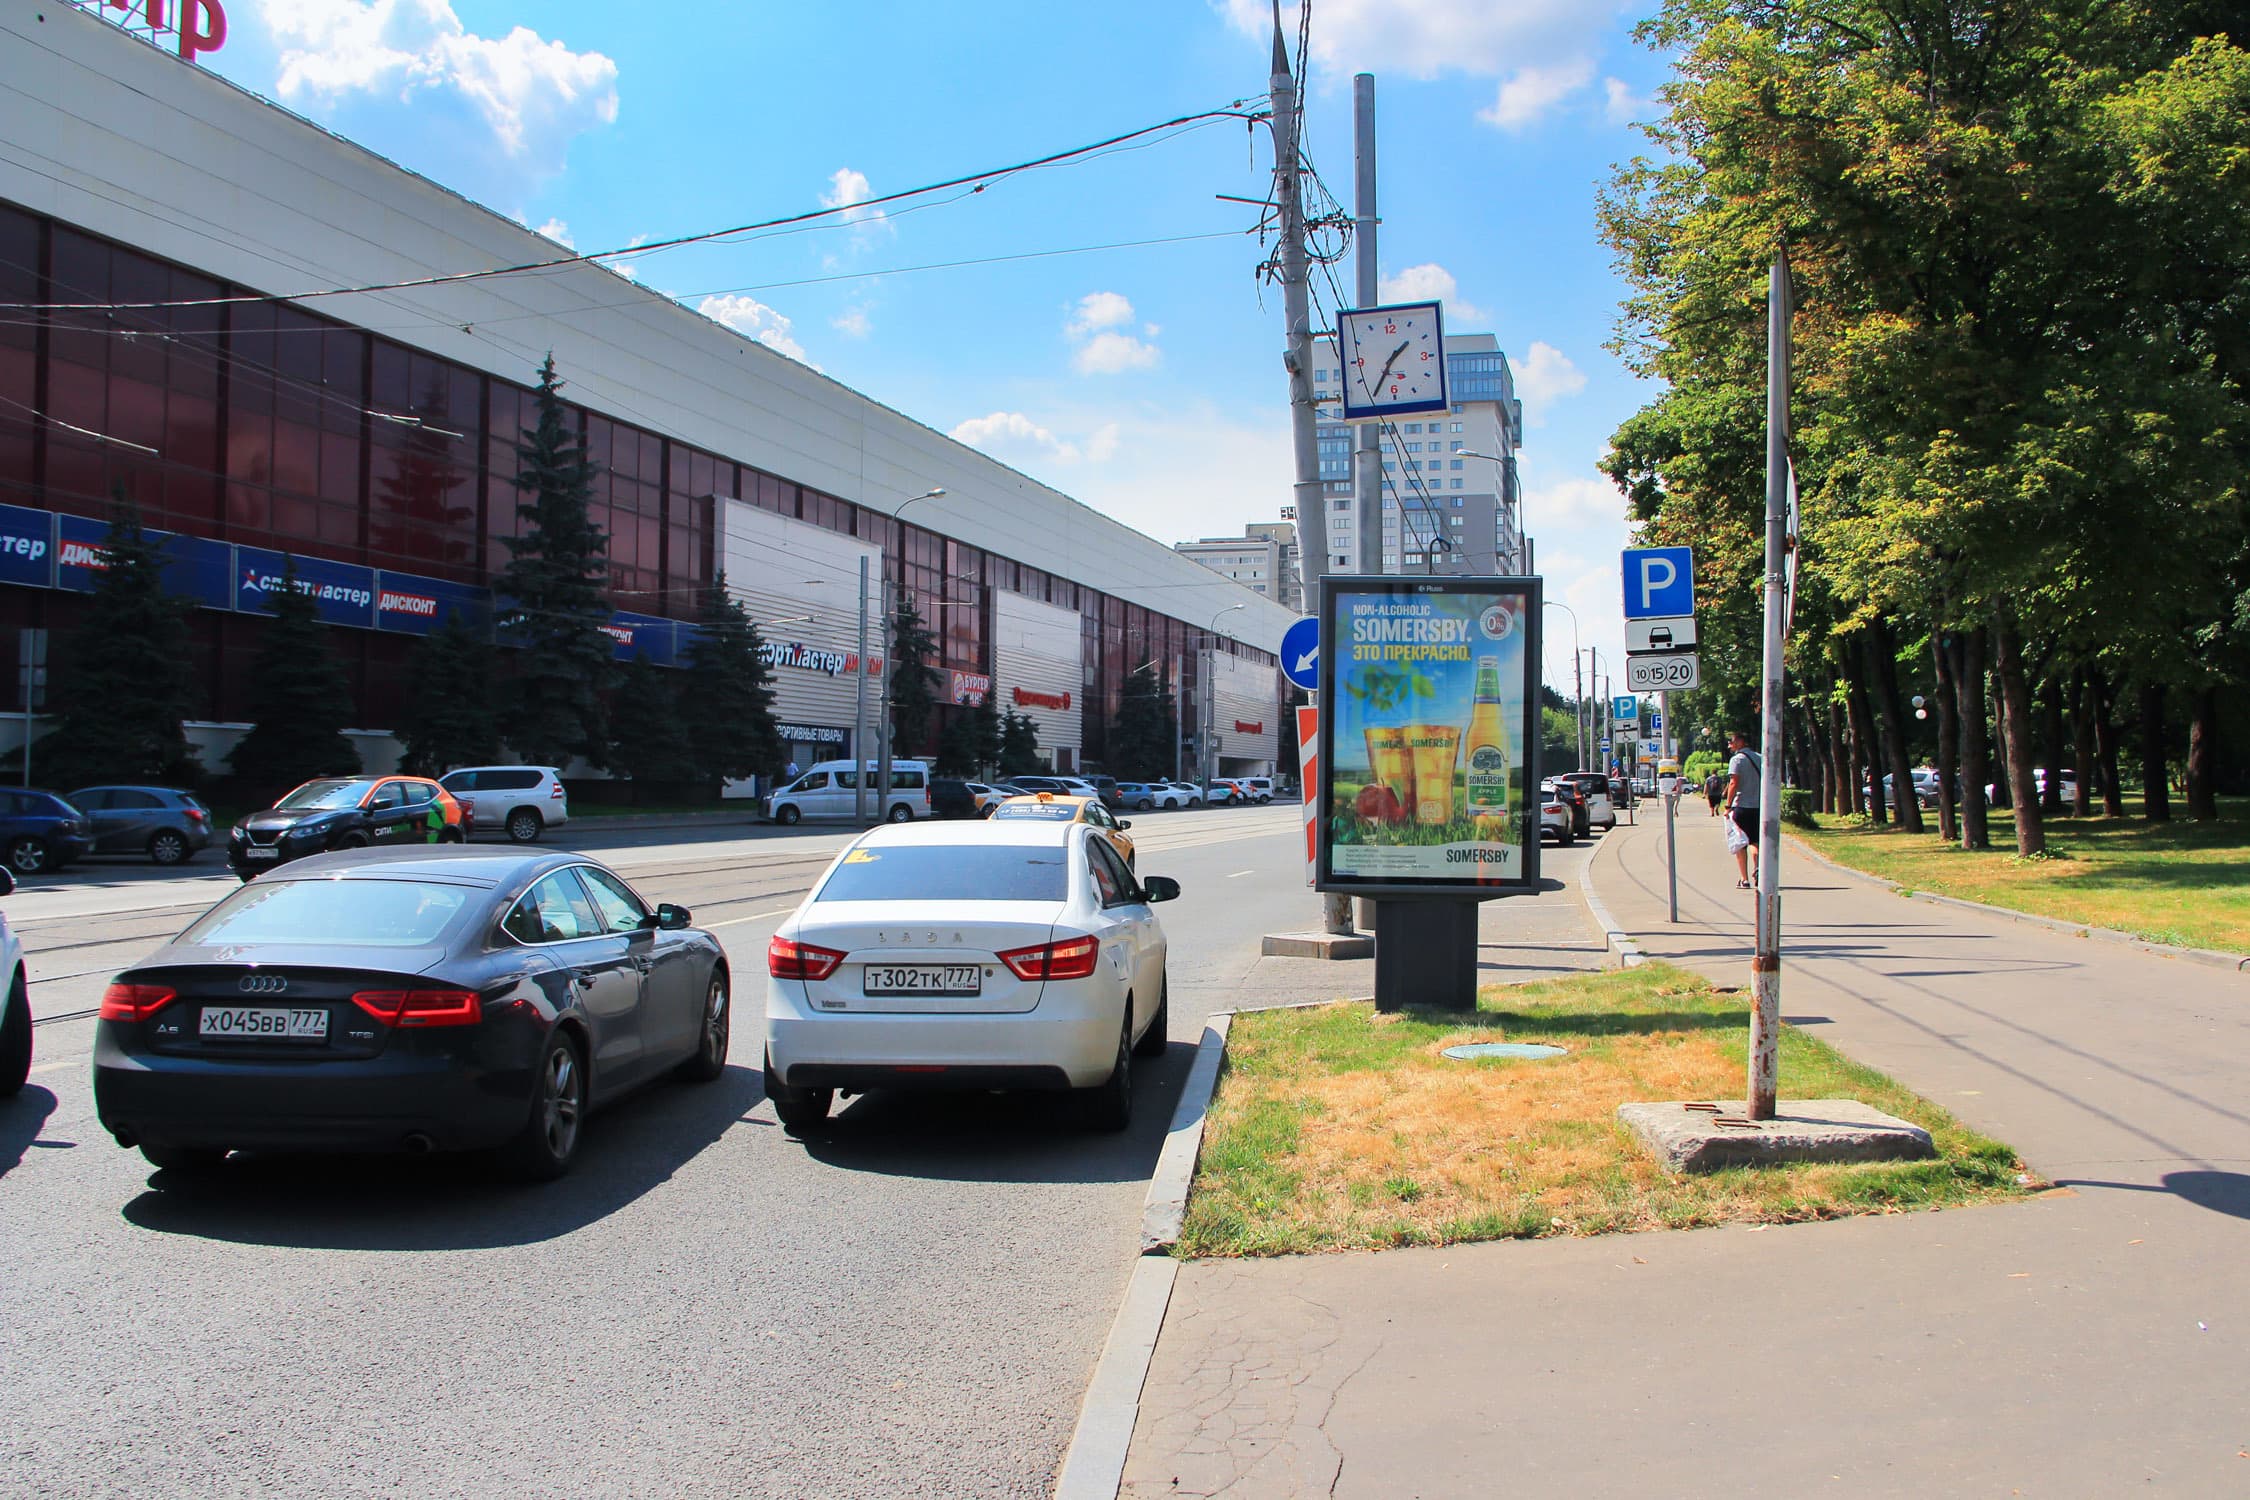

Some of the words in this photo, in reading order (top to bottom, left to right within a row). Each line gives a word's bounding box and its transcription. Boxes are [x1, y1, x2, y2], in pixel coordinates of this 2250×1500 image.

[1384, 324, 1397, 334] 12
[1357, 358, 1365, 367] 9
[1420, 351, 1429, 361] 3
[1390, 385, 1398, 394] 6
[0, 534, 46, 561] тер
[1640, 557, 1676, 608] P
[1353, 604, 1431, 616] NON-ALCOHOLIC
[1353, 618, 1473, 643] SOMERSBY.
[1353, 645, 1381, 661] ЭТО
[1384, 644, 1472, 662] ПРЕКРАСНО.
[1636, 669, 1647, 680] 10
[1651, 667, 1664, 680] 15
[1668, 665, 1690, 680] 20
[1620, 699, 1633, 717] P
[1469, 775, 1505, 785] SOMERSBY
[1446, 848, 1509, 864] SOMERSBY
[871, 968, 943, 988] Т302ТК
[946, 967, 974, 983] 777
[206, 1010, 287, 1033] Х045ВВ
[292, 1011, 321, 1028] 777
